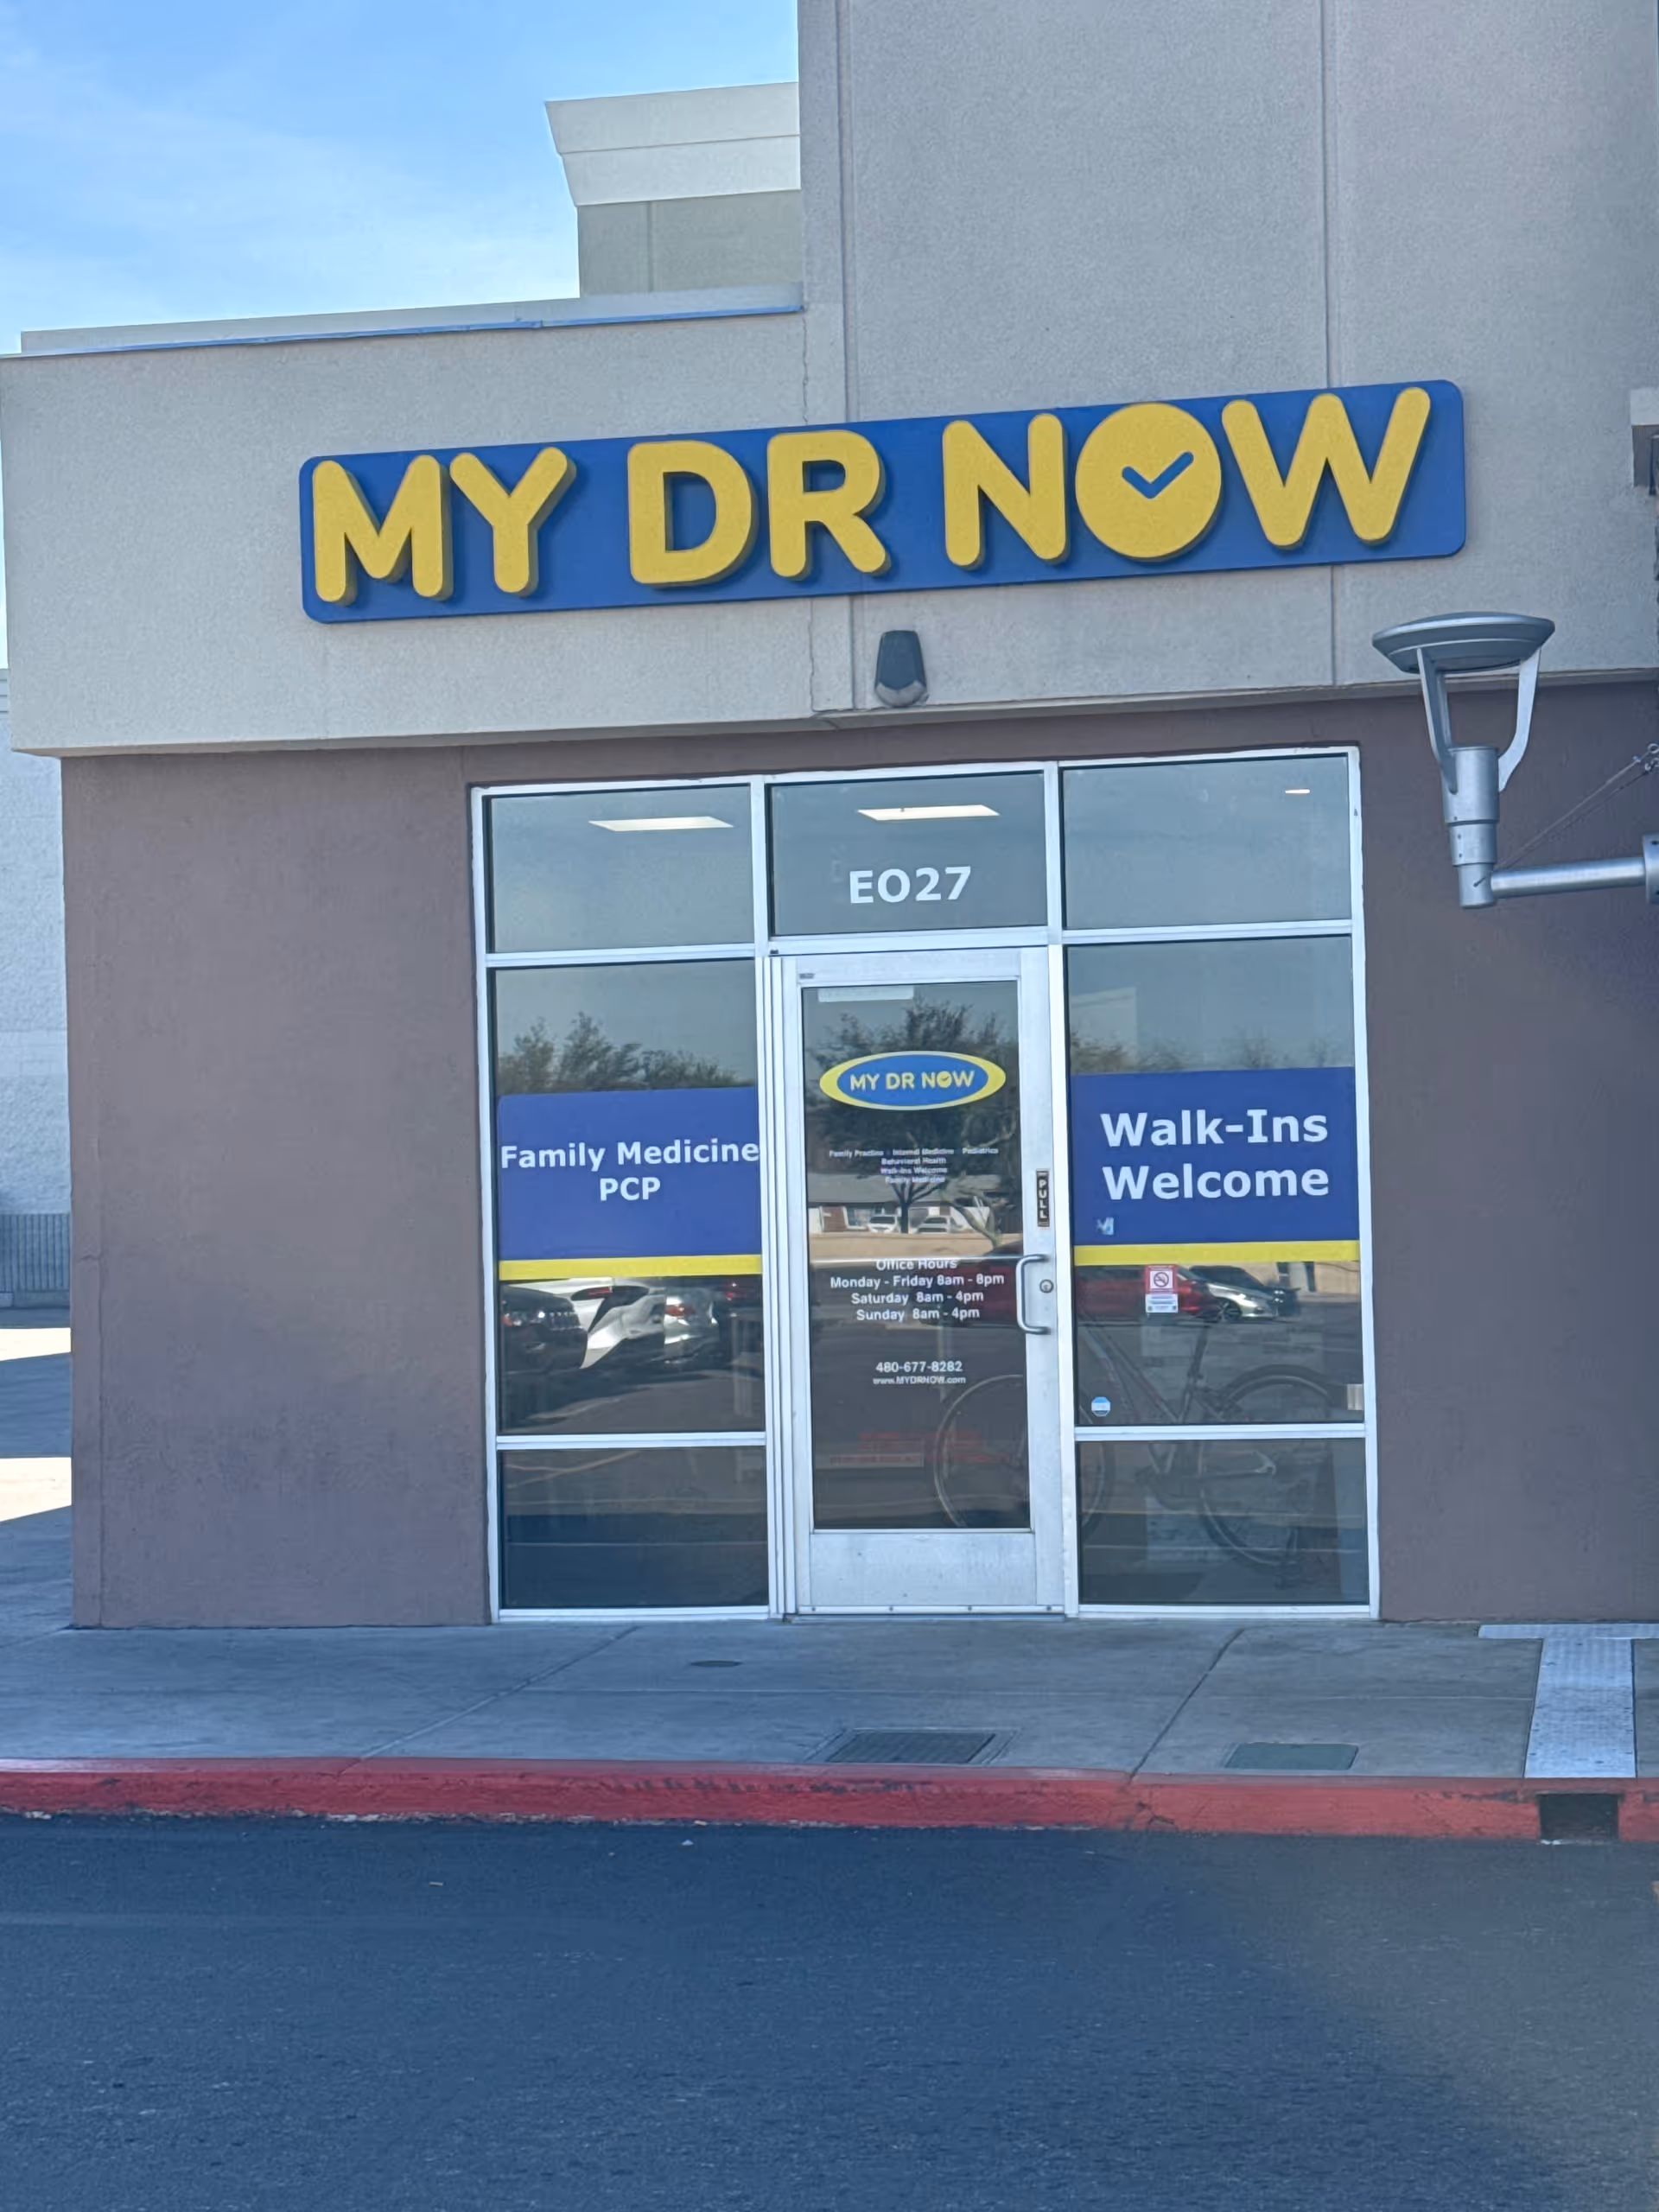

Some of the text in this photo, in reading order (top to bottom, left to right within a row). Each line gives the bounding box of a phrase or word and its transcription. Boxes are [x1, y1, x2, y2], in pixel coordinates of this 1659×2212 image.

[312, 387, 1430, 602] MY DR NOW
[849, 1070, 975, 1091] MY DR NOW
[1100, 1109, 1328, 1147] Walk-Ins
[501, 1138, 760, 1172] Family Medicine
[600, 1177, 661, 1201] PCP
[1102, 1163, 1329, 1200] Welcome
[1038, 1179, 1048, 1219] PULL
[875, 1258, 957, 1271] Office Hours
[830, 1276, 880, 1290] Monday
[893, 1274, 933, 1288] Friday
[937, 1274, 964, 1286] 8am
[976, 1273, 1005, 1287] 8pm
[851, 1292, 909, 1306] Saturday
[916, 1291, 944, 1303] 8am
[955, 1290, 984, 1305] 4pm
[856, 1308, 905, 1322] Sunday
[912, 1307, 940, 1319] 8am
[951, 1306, 980, 1322] 4pm
[875, 1361, 963, 1373] 480-677-8282
